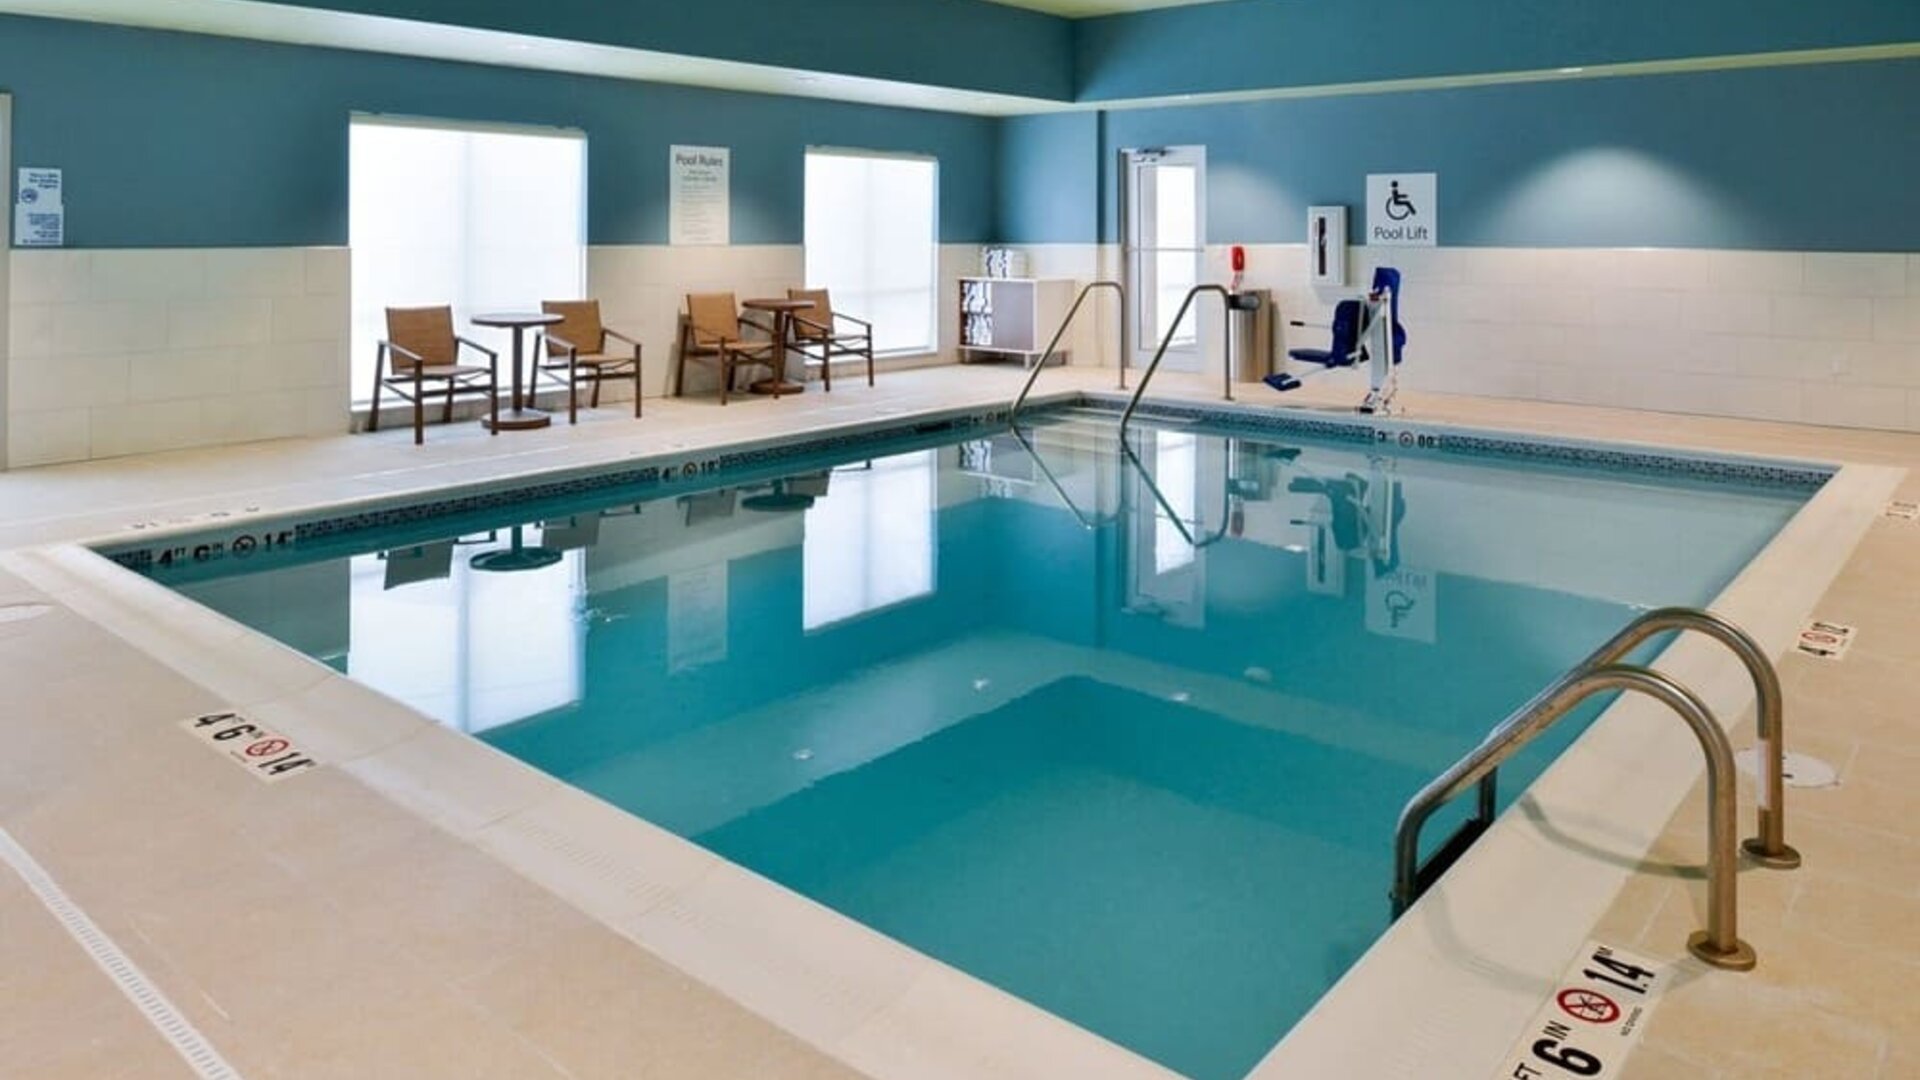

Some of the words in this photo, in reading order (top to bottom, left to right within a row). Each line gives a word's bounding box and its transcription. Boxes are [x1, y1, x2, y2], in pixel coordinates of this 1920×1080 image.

[676, 153, 697, 166] Pool
[1374, 226, 1403, 240] Pool
[1407, 226, 1429, 240] Lift
